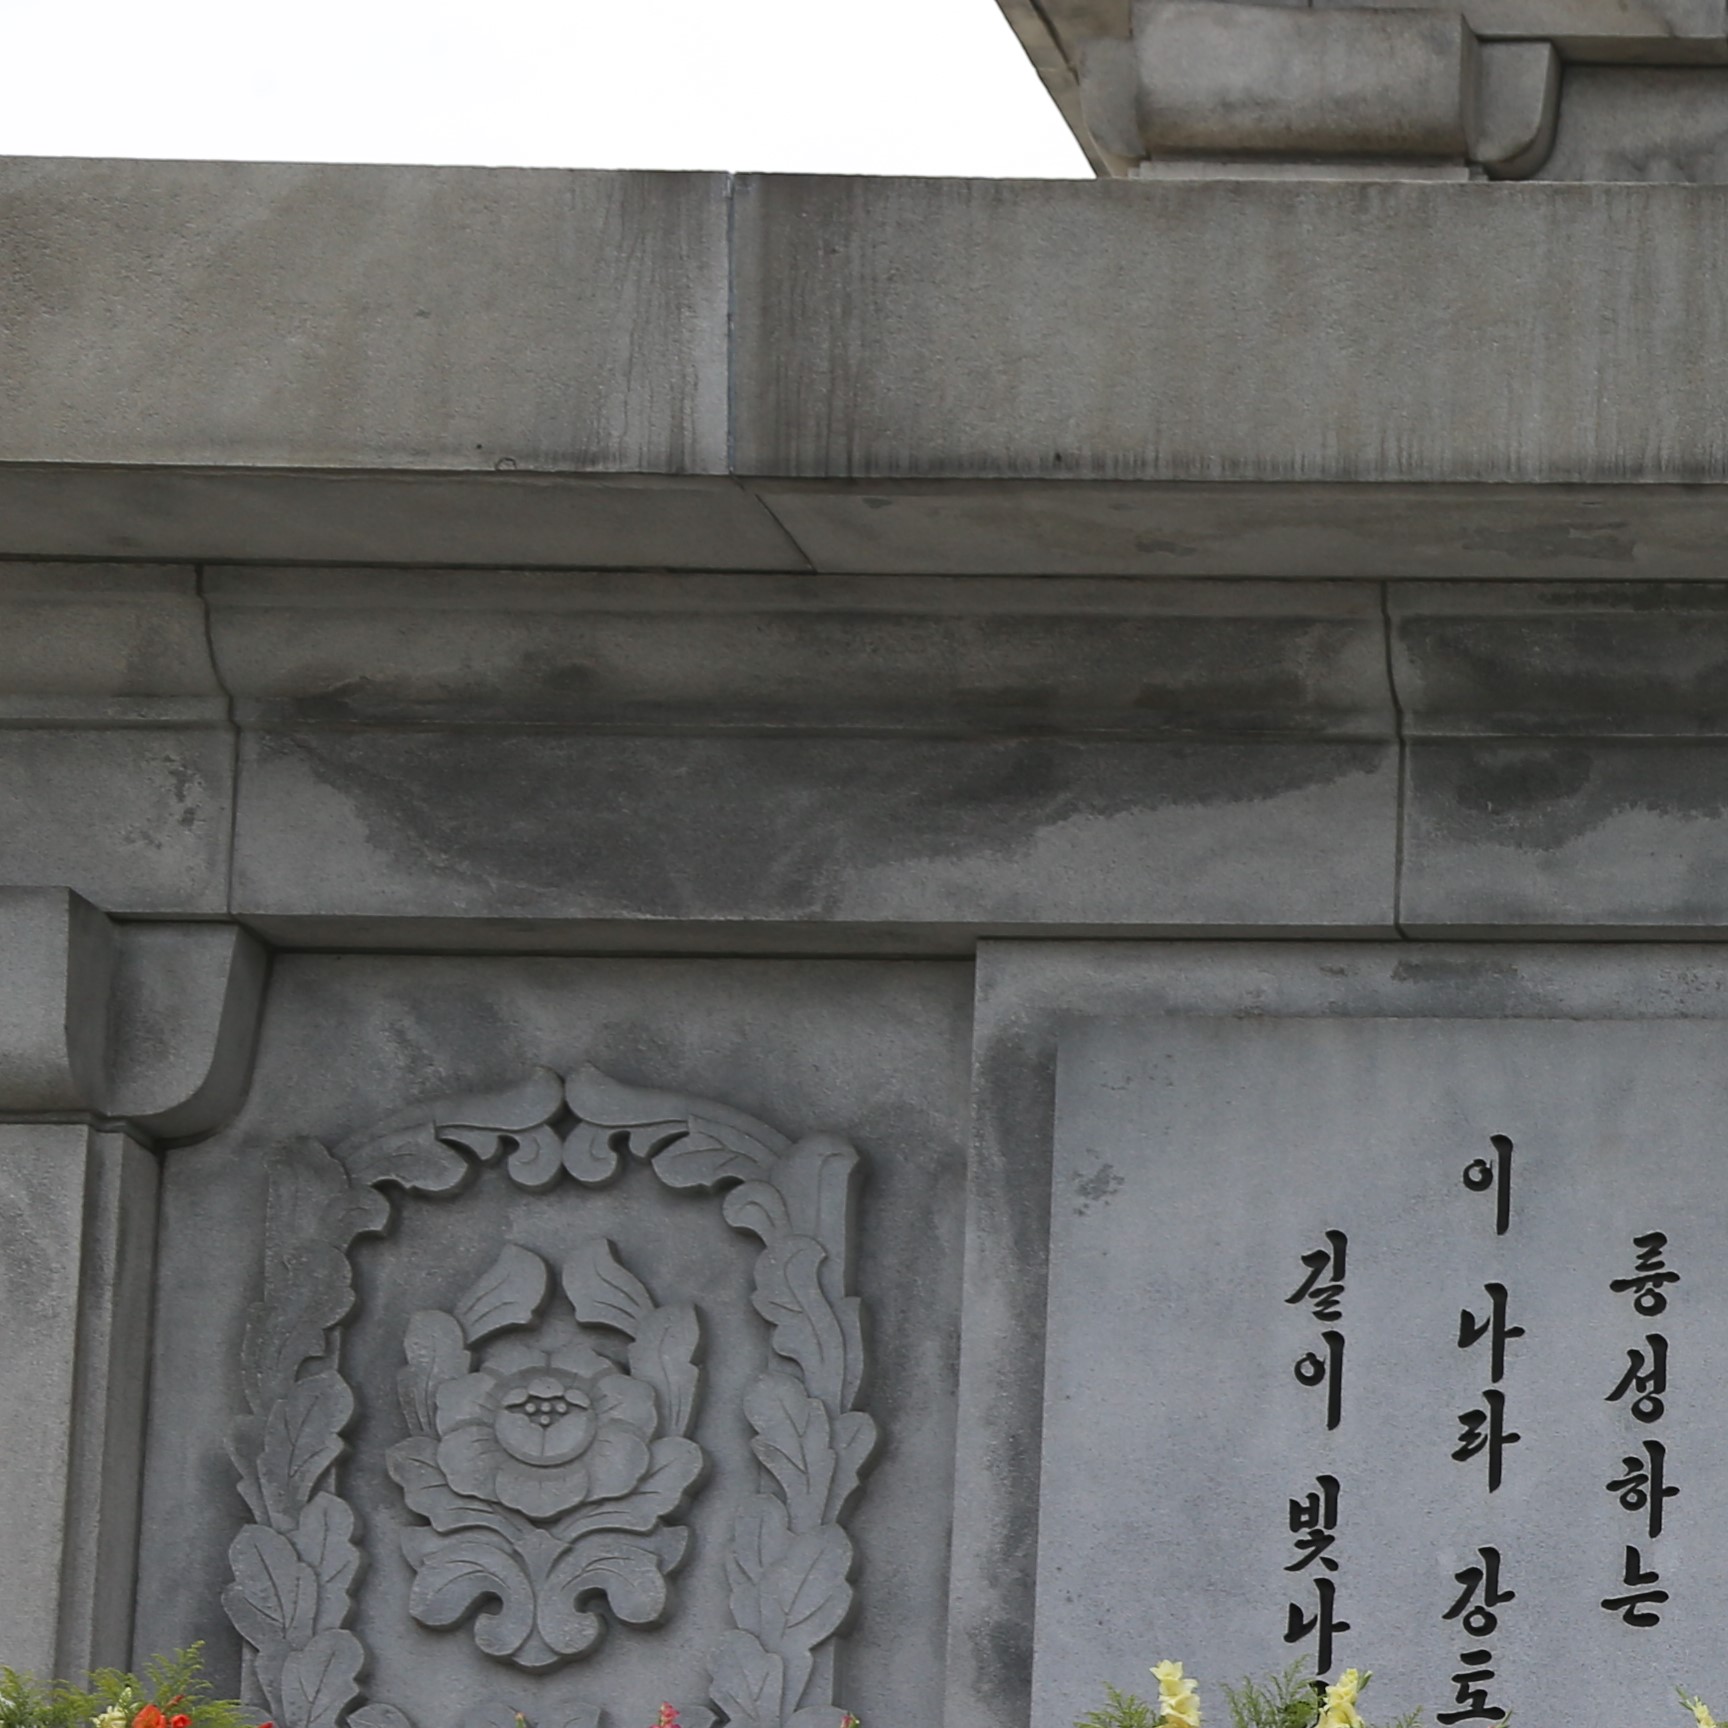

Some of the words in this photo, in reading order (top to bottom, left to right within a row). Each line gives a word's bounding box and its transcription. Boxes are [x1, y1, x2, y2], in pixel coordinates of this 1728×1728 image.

[1463, 1134, 1514, 1236] 이
[1287, 1229, 1348, 1431] 길이
[1451, 1282, 1525, 1493] 나라
[1600, 1231, 1680, 1628] 륭성하는
